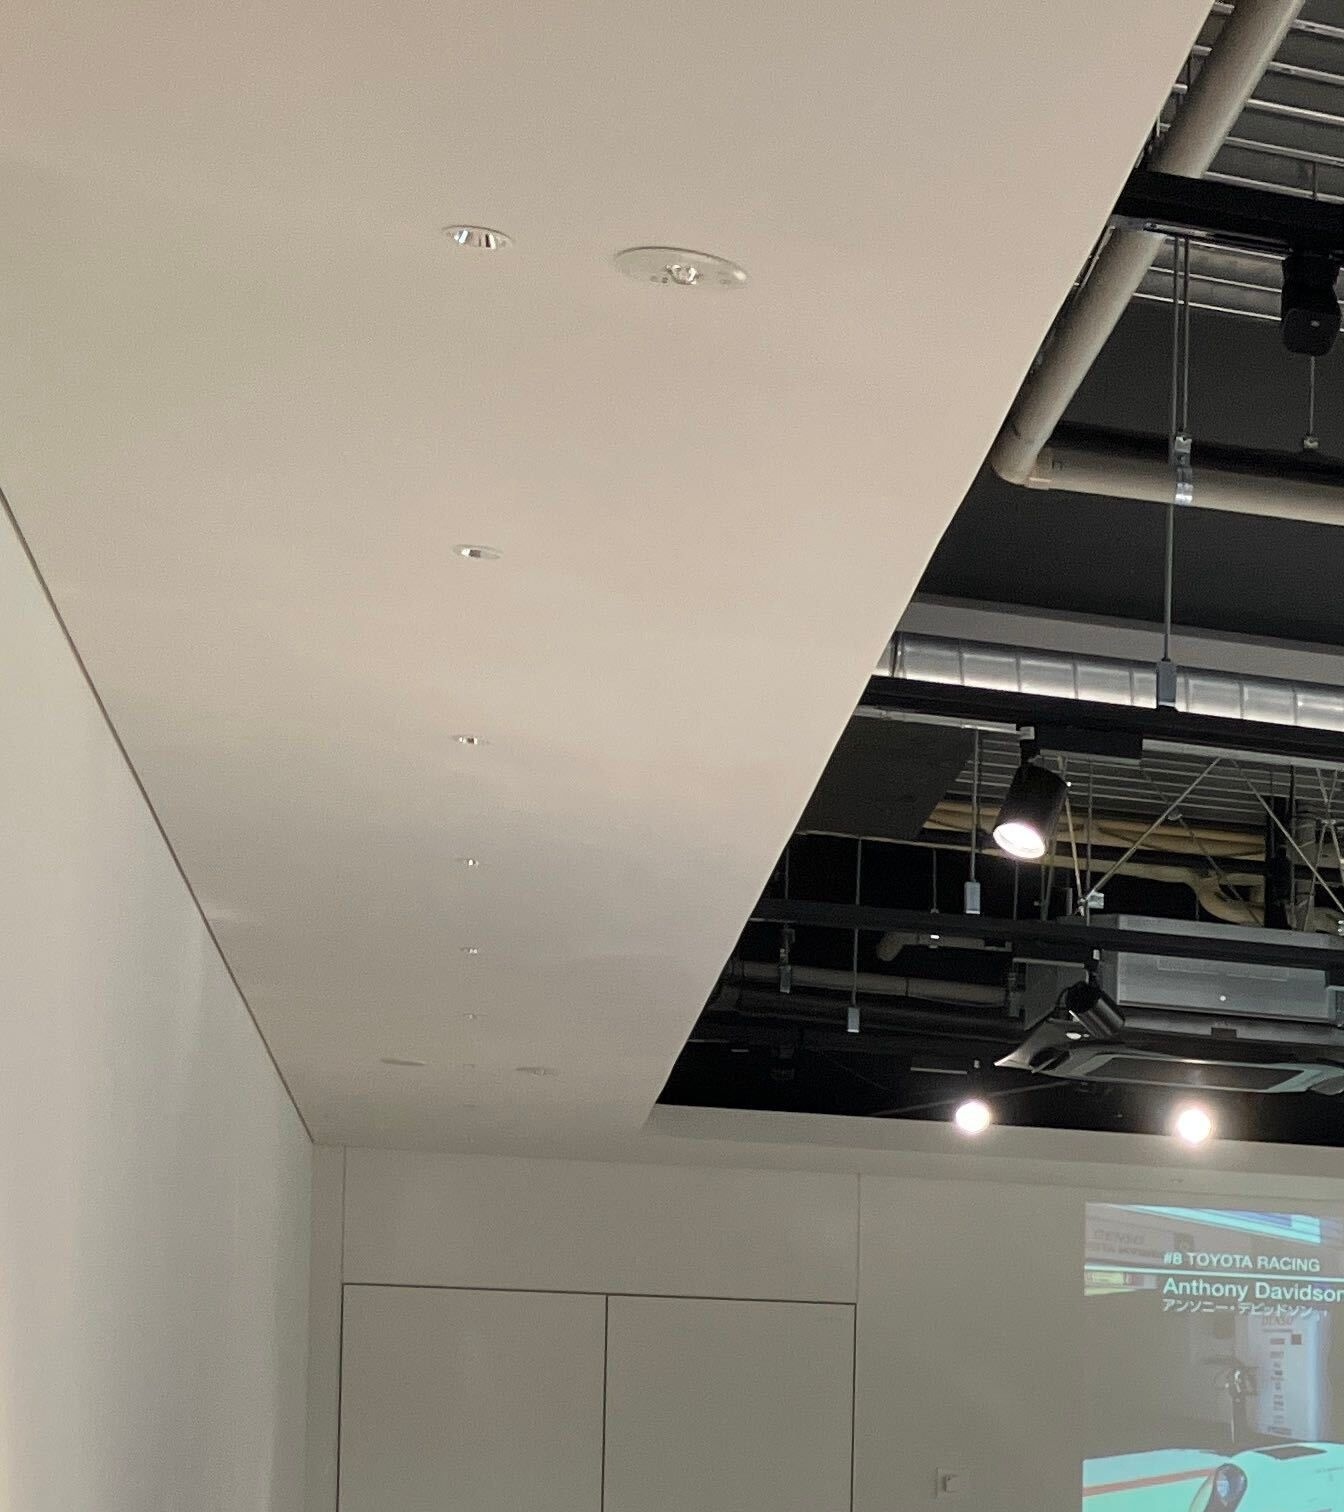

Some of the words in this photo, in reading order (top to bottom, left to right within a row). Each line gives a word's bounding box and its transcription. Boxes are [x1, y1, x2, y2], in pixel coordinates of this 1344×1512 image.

[1186, 1252, 1253, 1269] TOYOTA
[1256, 1255, 1321, 1273] RACING
[1162, 1277, 1249, 1302] Anthony
